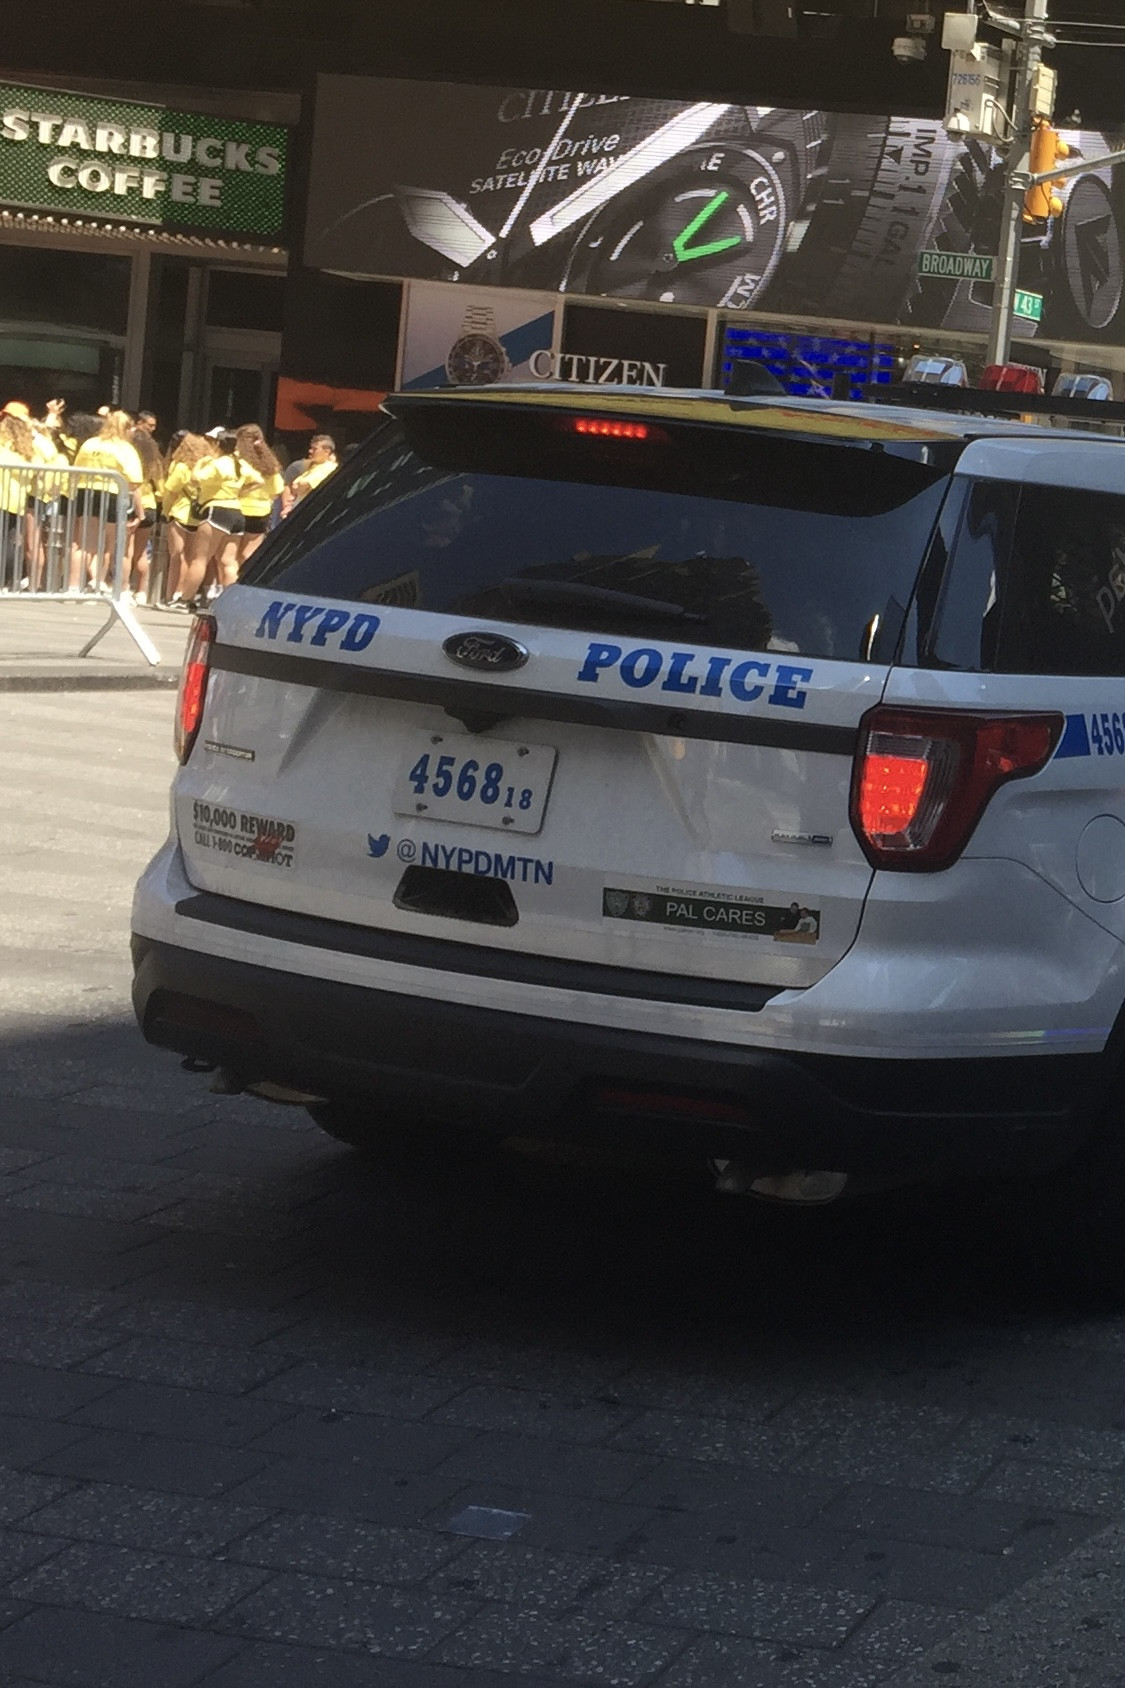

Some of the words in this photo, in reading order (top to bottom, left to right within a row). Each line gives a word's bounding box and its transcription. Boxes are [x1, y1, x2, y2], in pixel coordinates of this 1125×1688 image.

[0, 108, 280, 176] STARBUCKS
[47, 157, 224, 207] COFFEE
[921, 253, 990, 278] BROADWAY
[1020, 296, 1032, 315] 43
[529, 350, 667, 387] CITIZEN
[255, 601, 381, 652] NYPD
[456, 636, 506, 663] Ford
[577, 642, 814, 710] POLICE
[409, 753, 504, 805] 4568
[193, 802, 237, 830] $10,000
[240, 814, 296, 843] REWARD
[396, 838, 554, 886] @NYPDMTN
[666, 902, 698, 919] PAL
[703, 906, 766, 926] CARES
